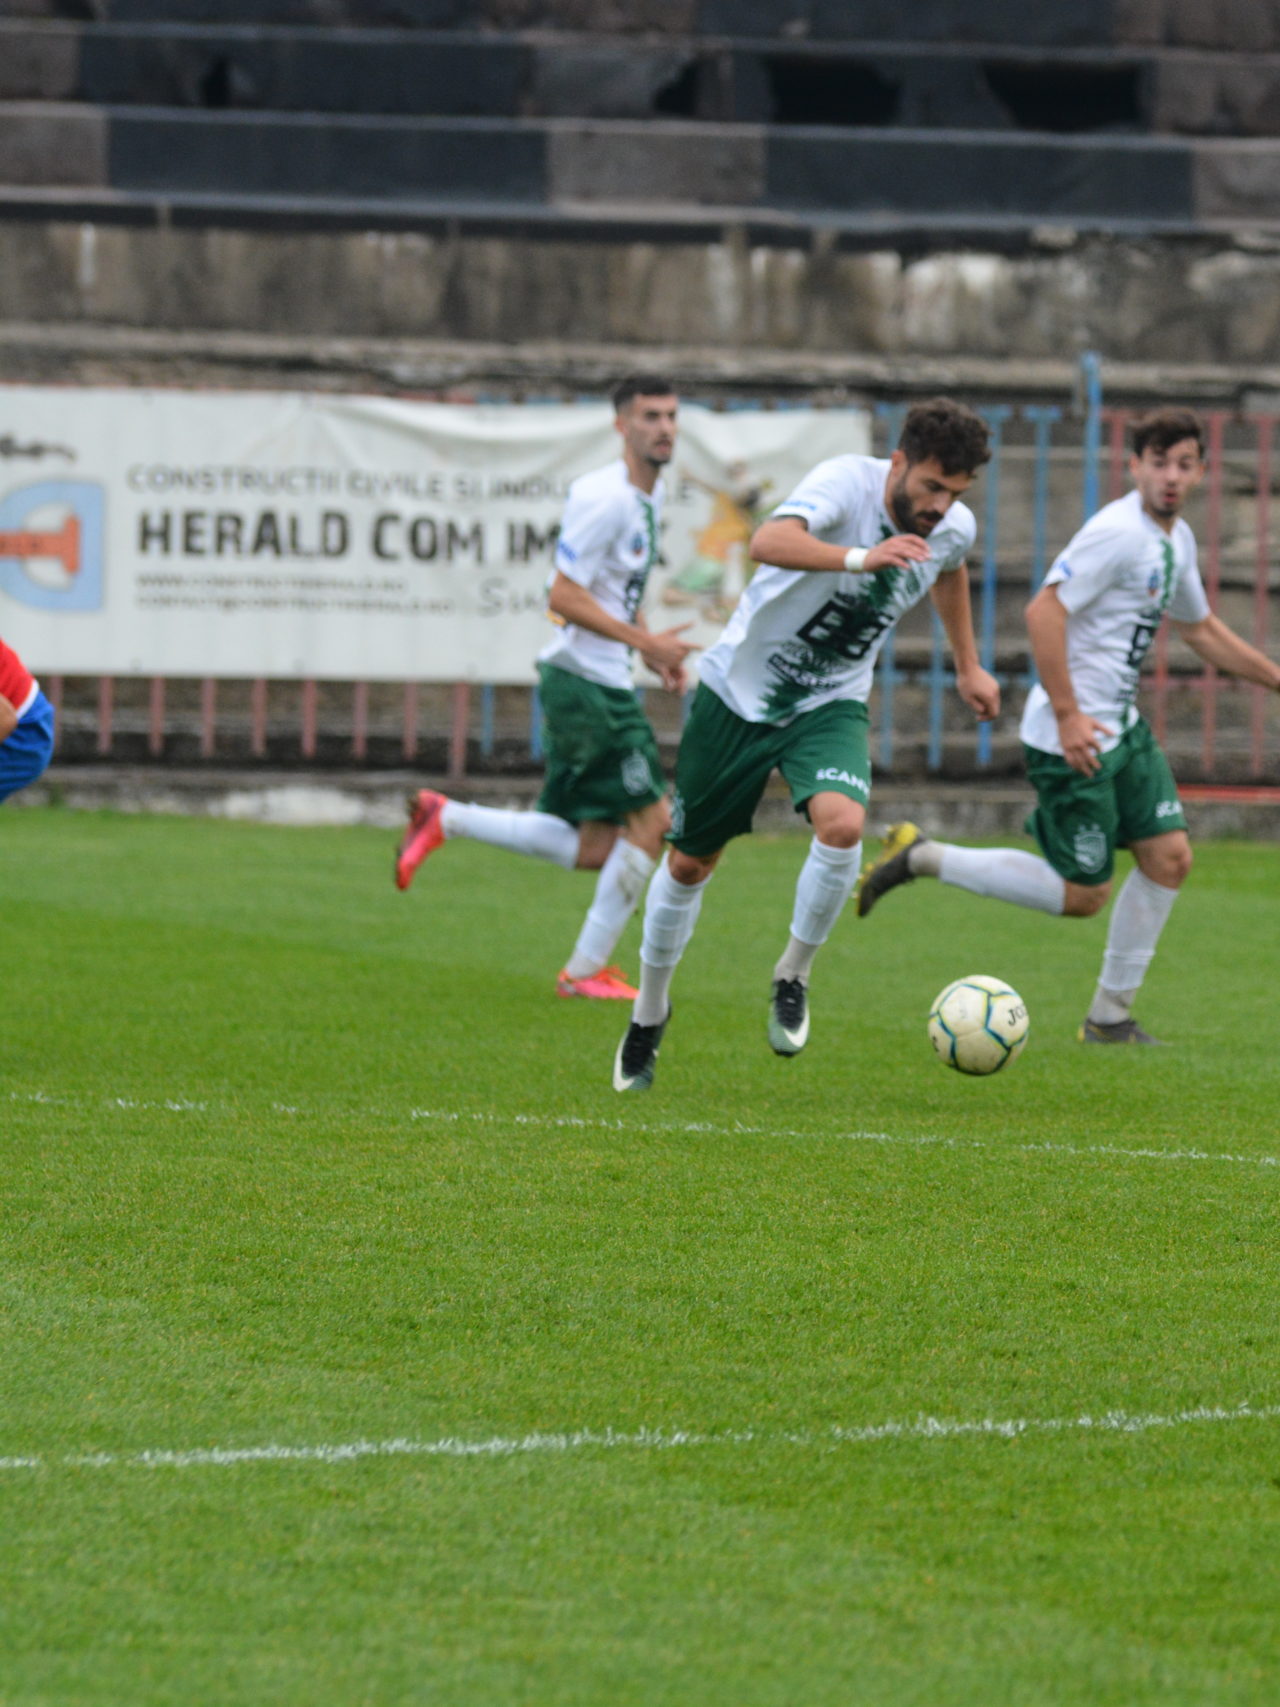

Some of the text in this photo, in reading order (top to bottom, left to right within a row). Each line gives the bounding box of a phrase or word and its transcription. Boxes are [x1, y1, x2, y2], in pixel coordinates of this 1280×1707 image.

[125, 462, 340, 497] CONSTRUCTII
[138, 510, 350, 560] HERALD
[372, 512, 486, 564] COM
